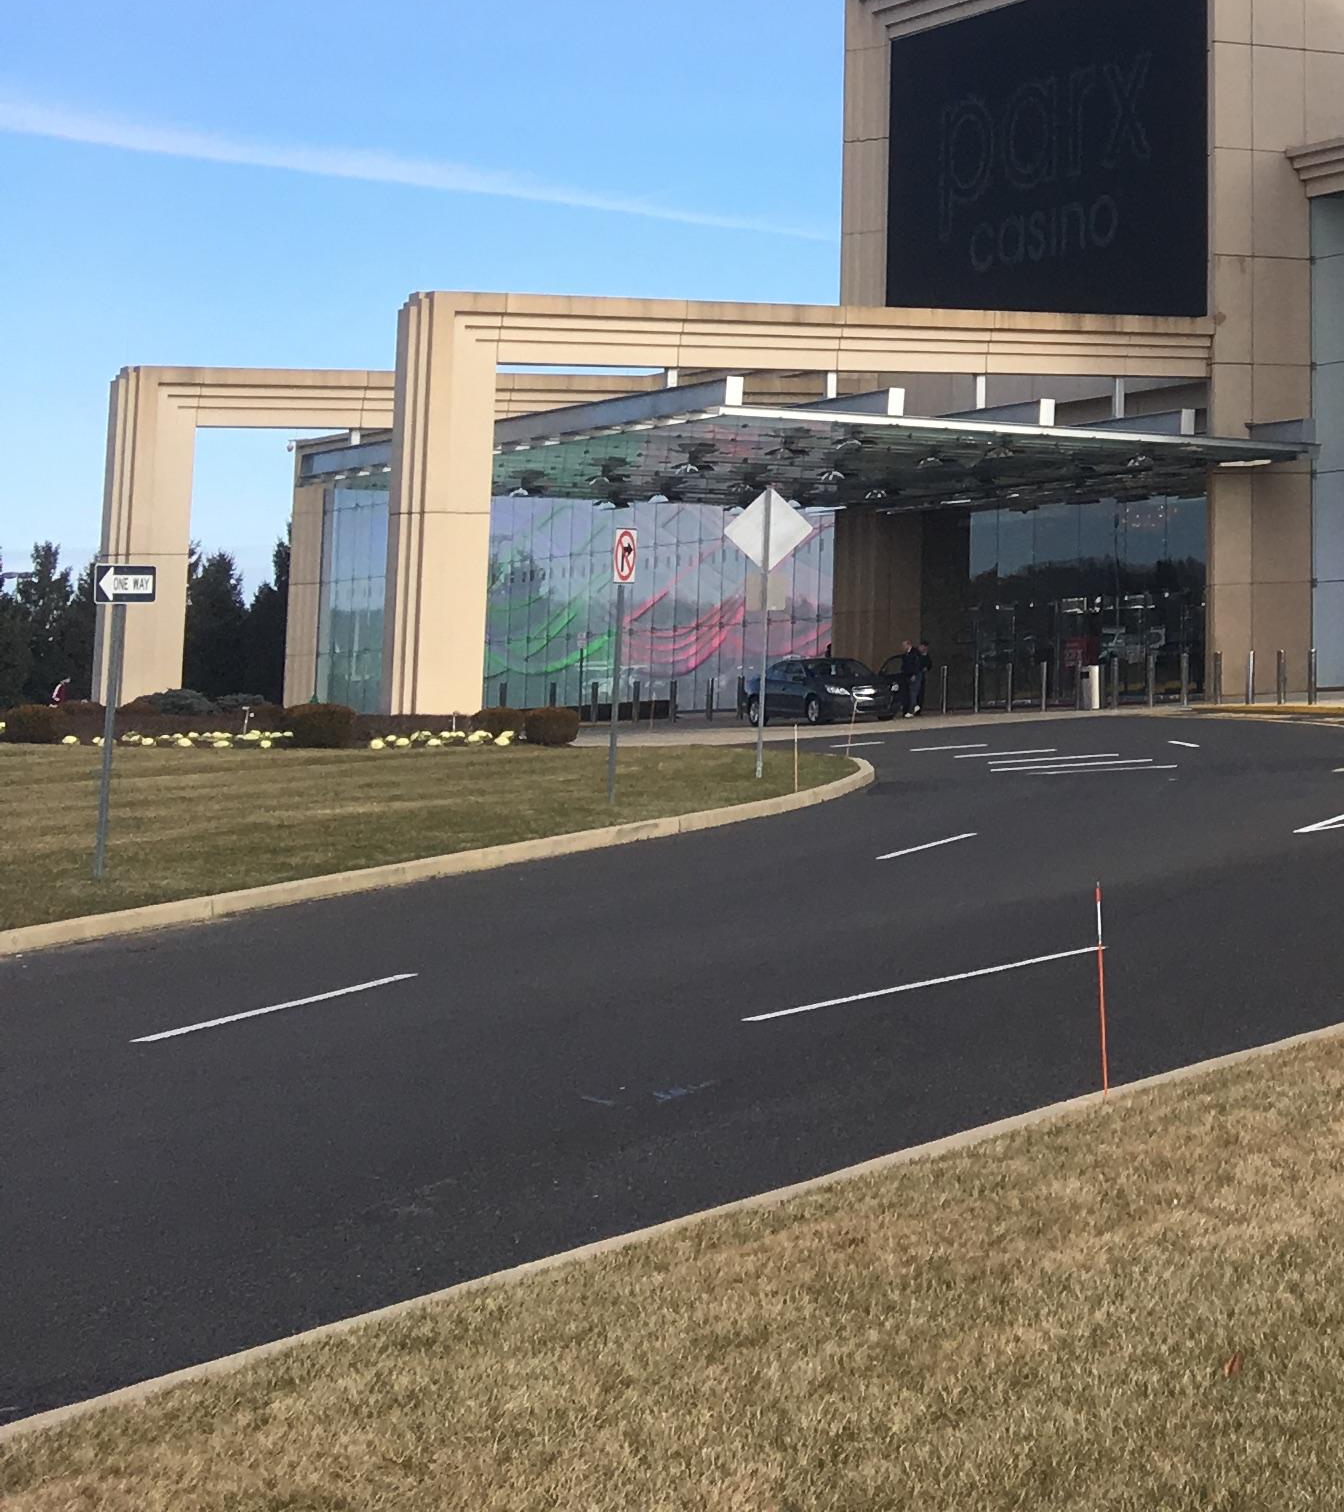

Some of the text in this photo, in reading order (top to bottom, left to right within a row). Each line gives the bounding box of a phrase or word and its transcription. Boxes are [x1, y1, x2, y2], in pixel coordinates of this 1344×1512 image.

[938, 51, 1152, 243] parx
[970, 195, 1119, 273] casino
[113, 577, 150, 591] ONE WAY
